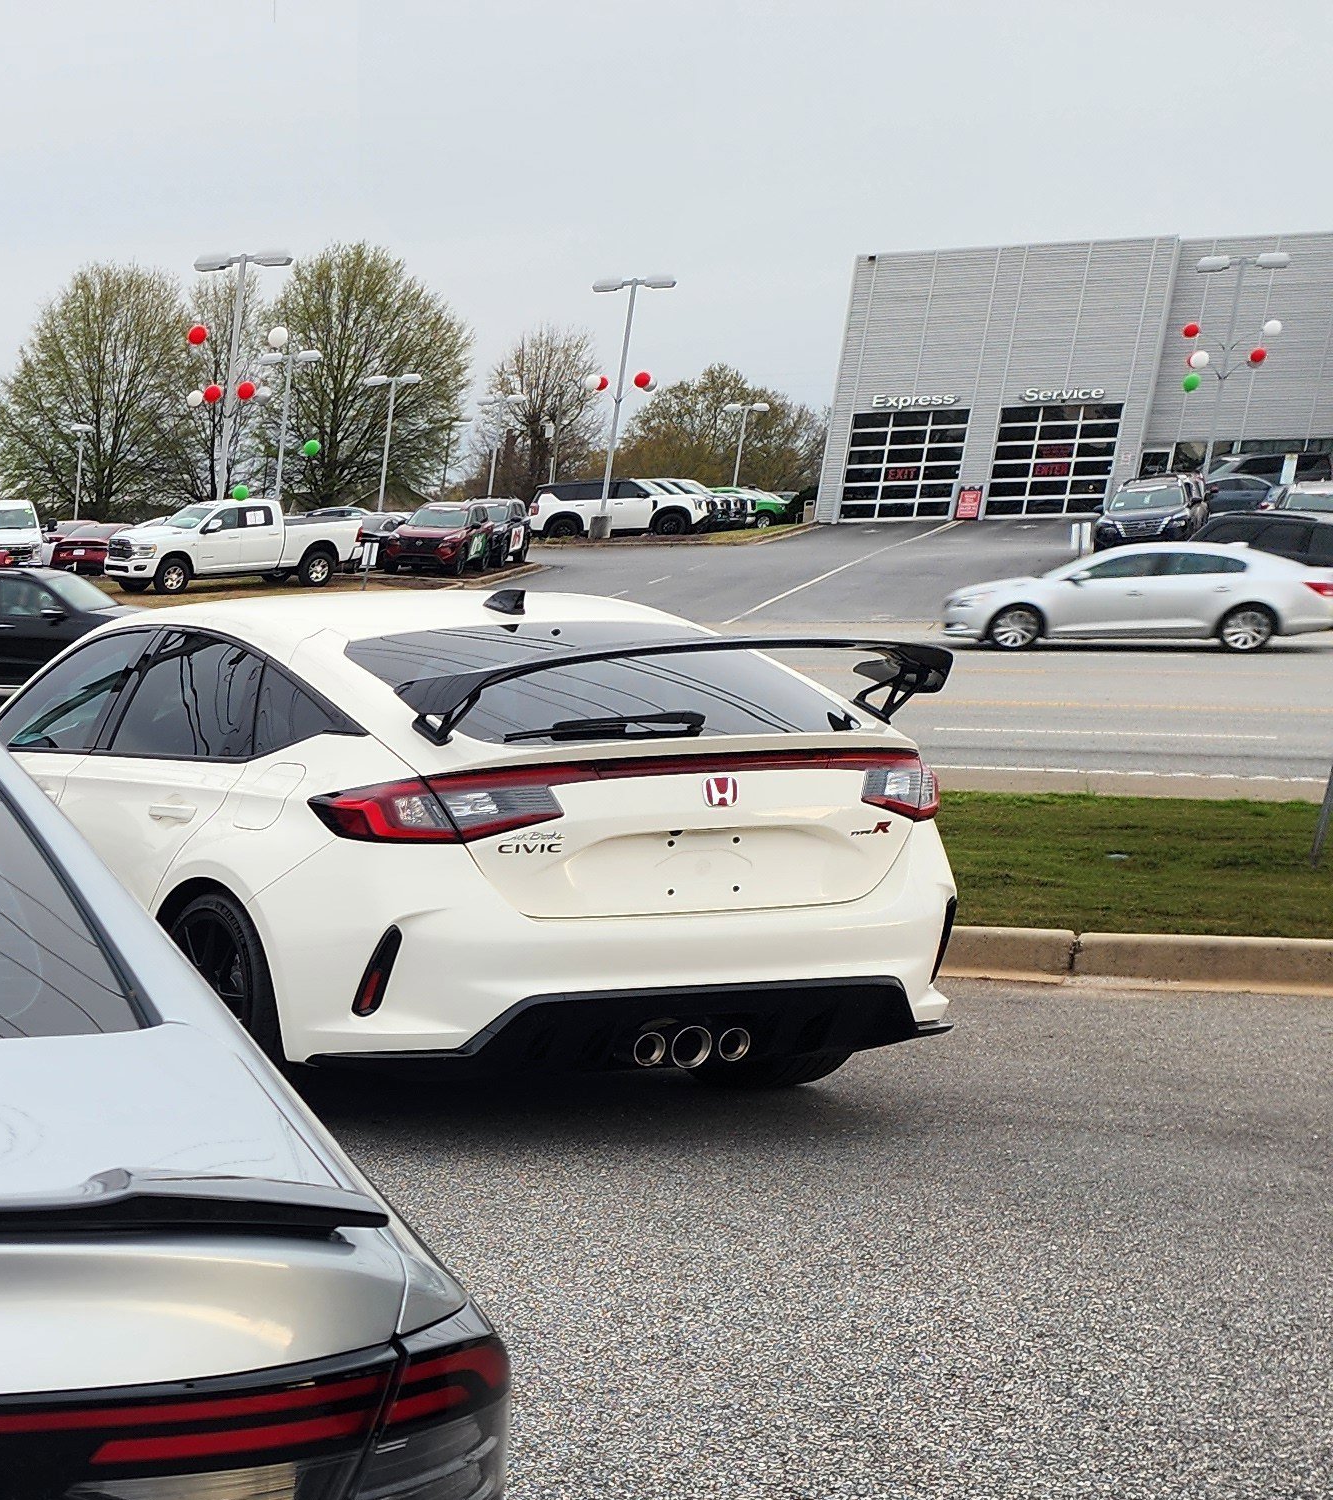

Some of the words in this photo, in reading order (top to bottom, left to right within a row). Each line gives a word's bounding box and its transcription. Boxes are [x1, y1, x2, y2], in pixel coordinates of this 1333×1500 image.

[872, 394, 956, 410] Express
[1024, 387, 1105, 402] Service
[887, 467, 917, 480] EXIT
[497, 843, 562, 854] CIVIC
